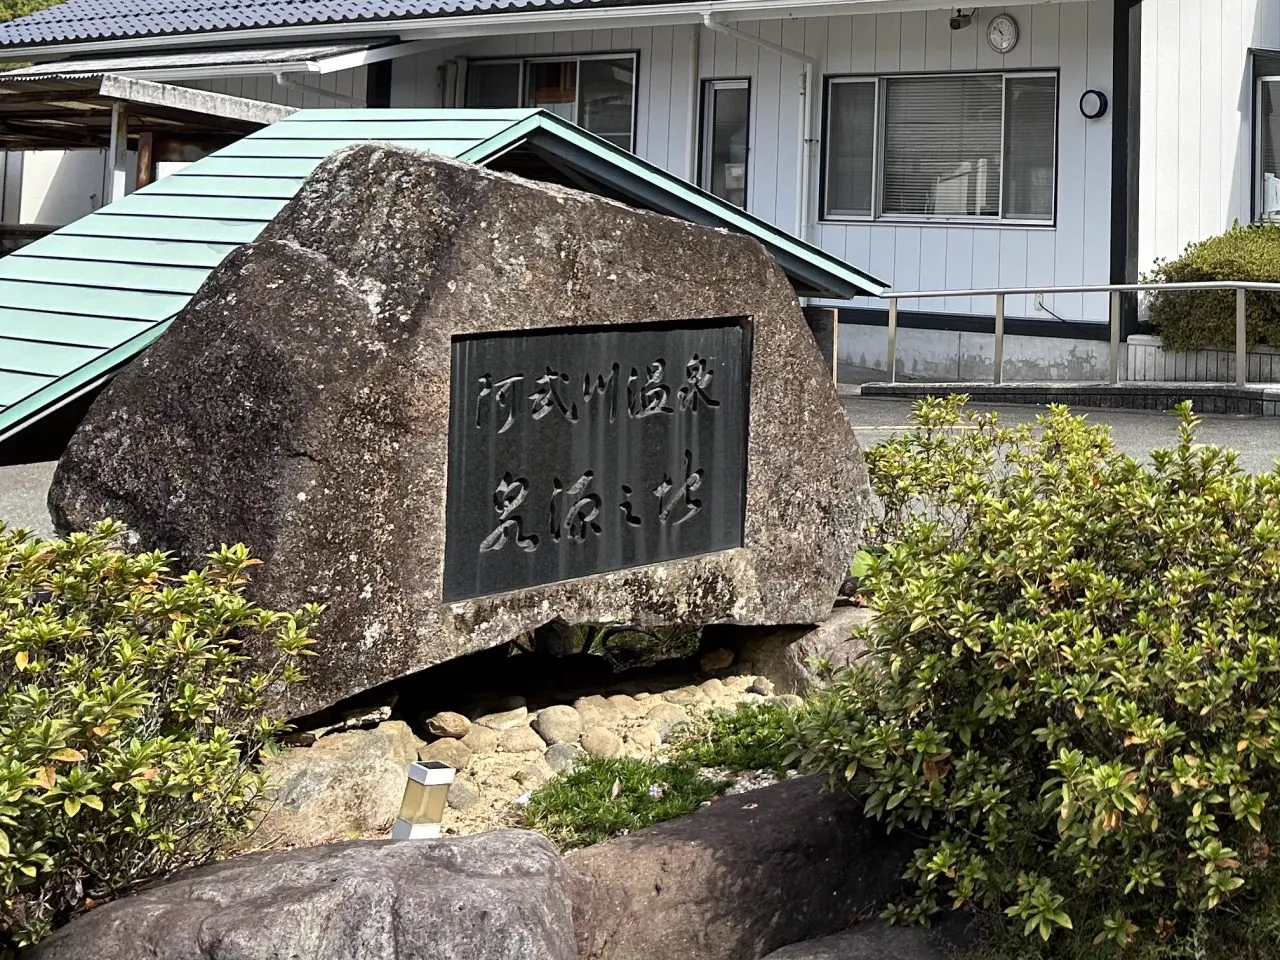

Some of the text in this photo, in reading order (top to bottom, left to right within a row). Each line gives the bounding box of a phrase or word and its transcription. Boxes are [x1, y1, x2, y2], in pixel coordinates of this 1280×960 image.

[475, 352, 721, 435] 阿武川温泉
